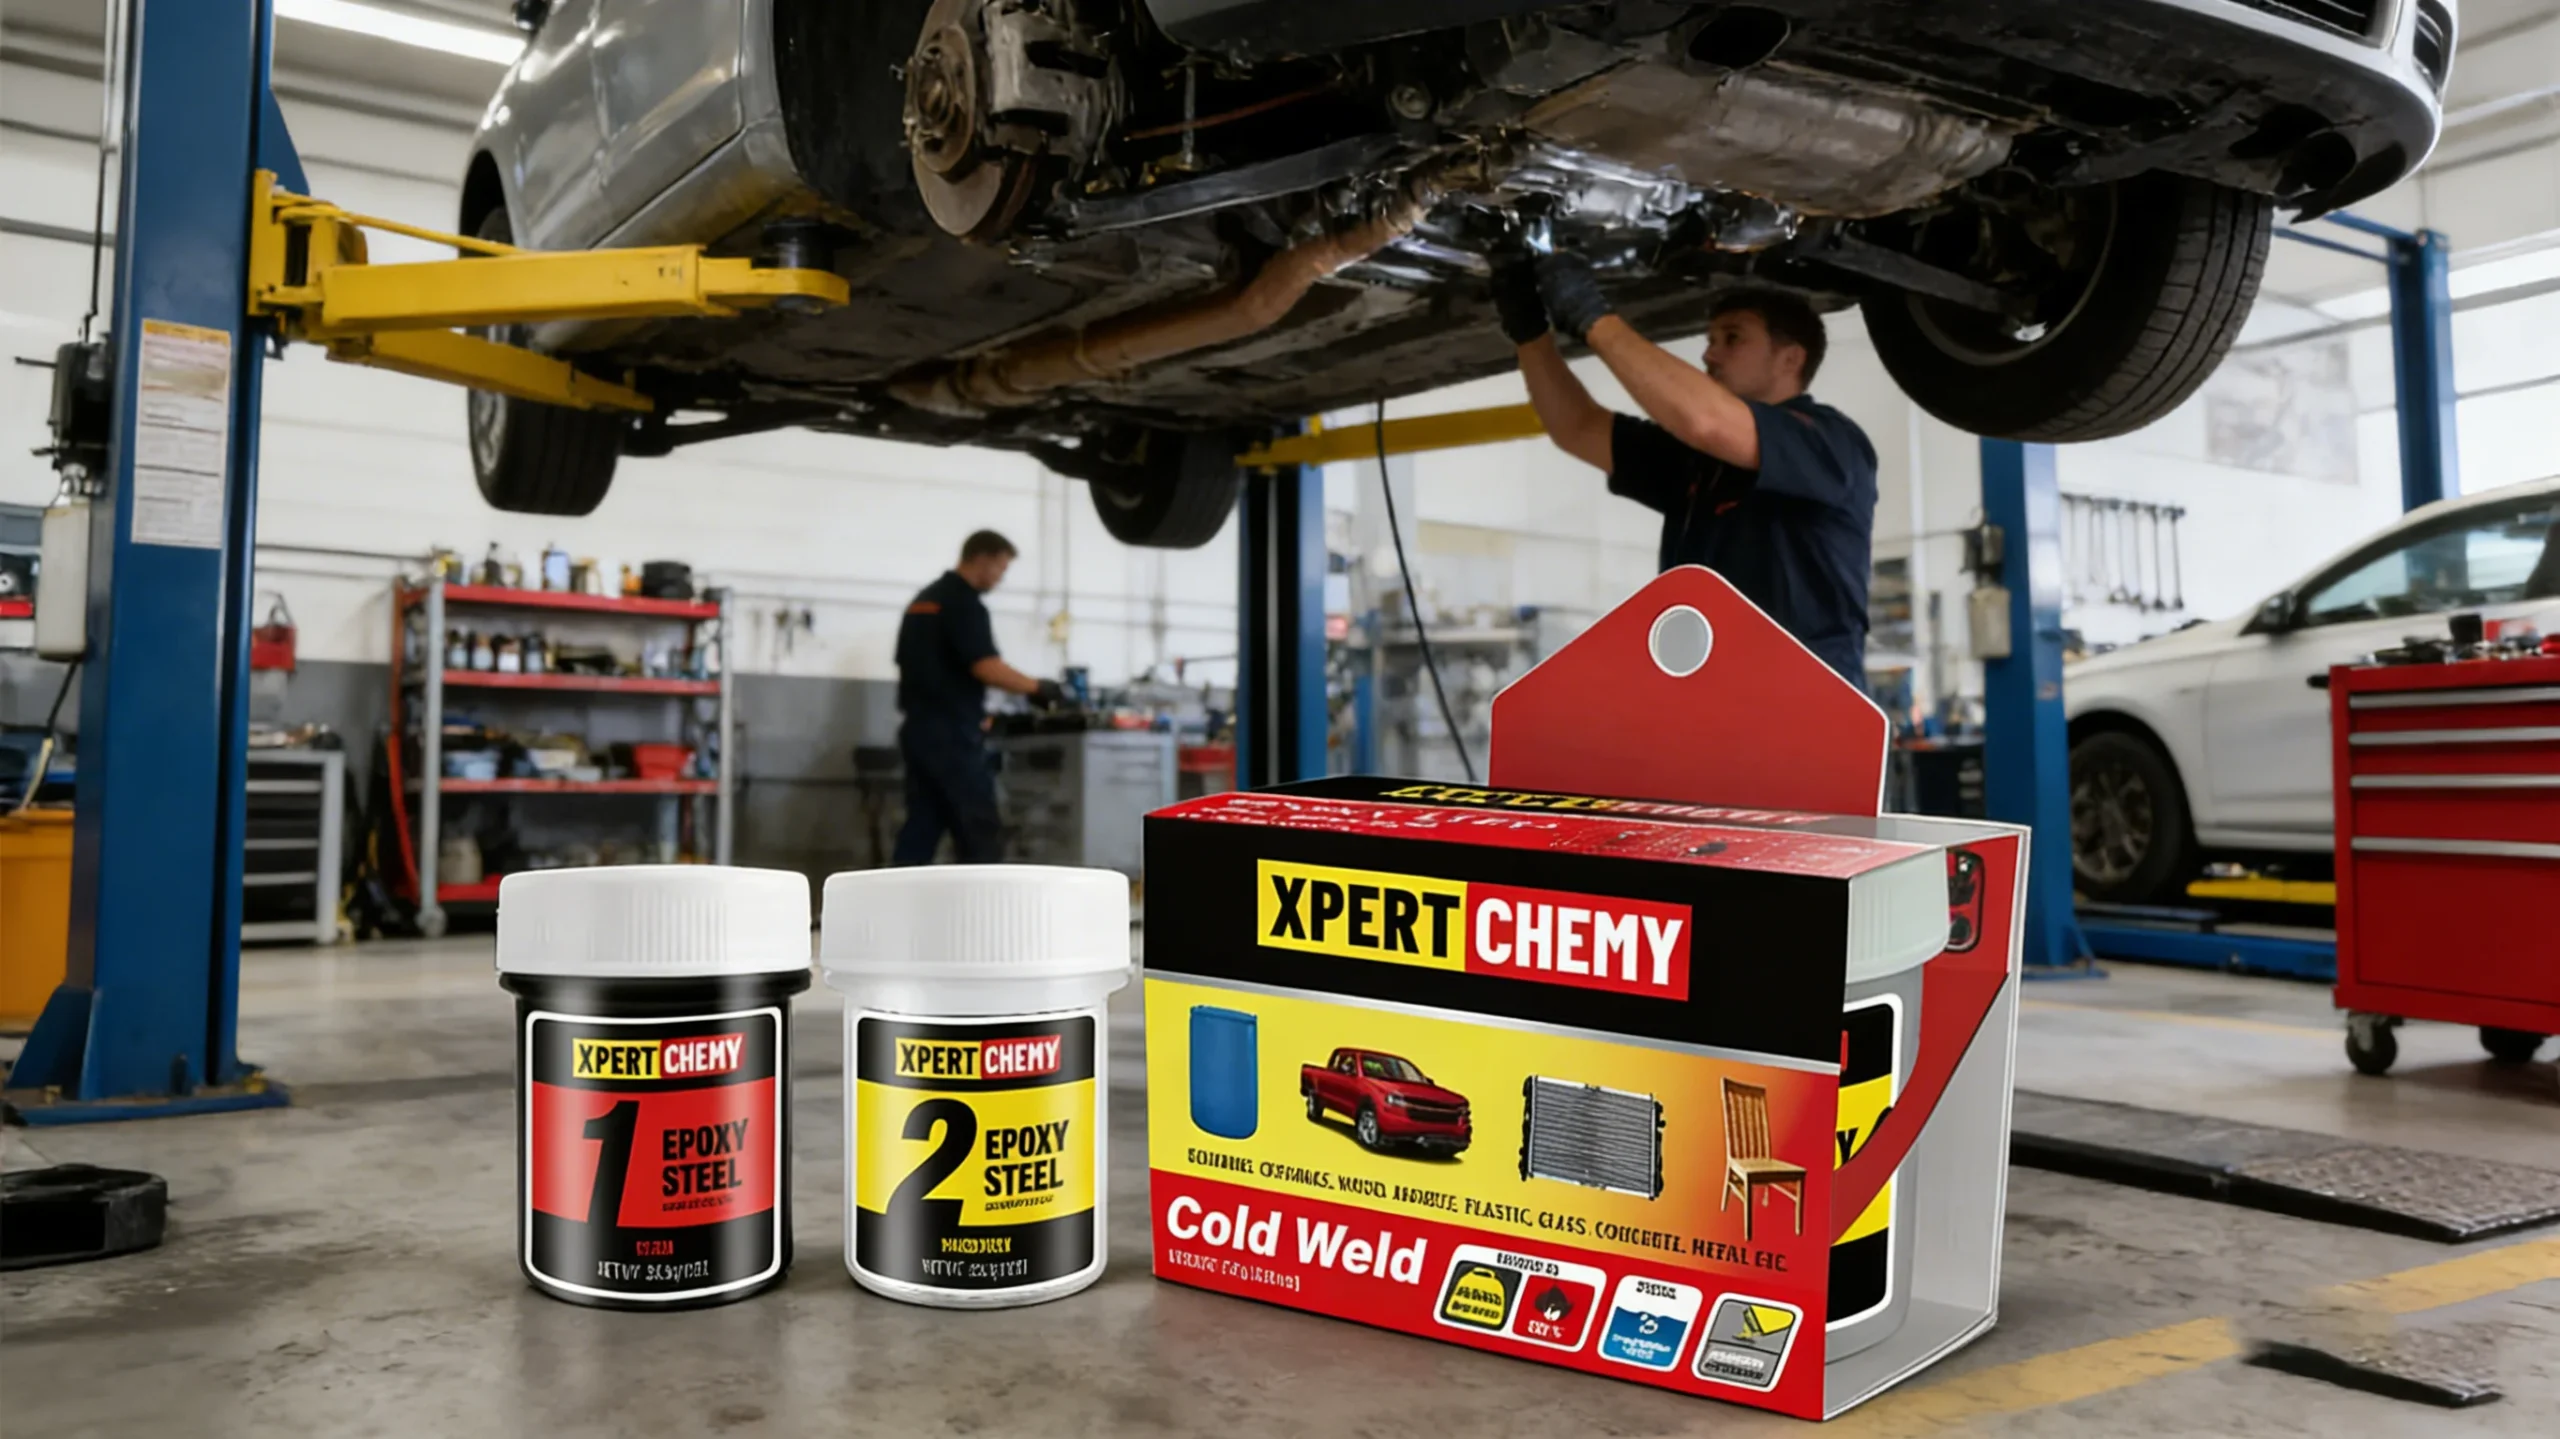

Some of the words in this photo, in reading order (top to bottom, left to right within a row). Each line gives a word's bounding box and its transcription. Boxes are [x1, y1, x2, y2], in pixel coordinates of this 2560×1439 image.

[1270, 874, 1461, 959] XPERT
[1475, 897, 1684, 986] CHEMY
[578, 1043, 659, 1076] XPERT
[664, 1036, 743, 1074] CHEMY
[900, 1043, 979, 1076] XPERT
[984, 1035, 1061, 1074] CHEMY
[662, 1118, 748, 1161] EPOXY
[985, 1119, 1070, 1160] EPOXY
[582, 1100, 640, 1226] 1
[662, 1158, 742, 1197] STEEL
[886, 1098, 978, 1226] 2
[984, 1158, 1064, 1197] STEEL
[1167, 1195, 1283, 1258] Cold
[1296, 1217, 1428, 1285] Weld
